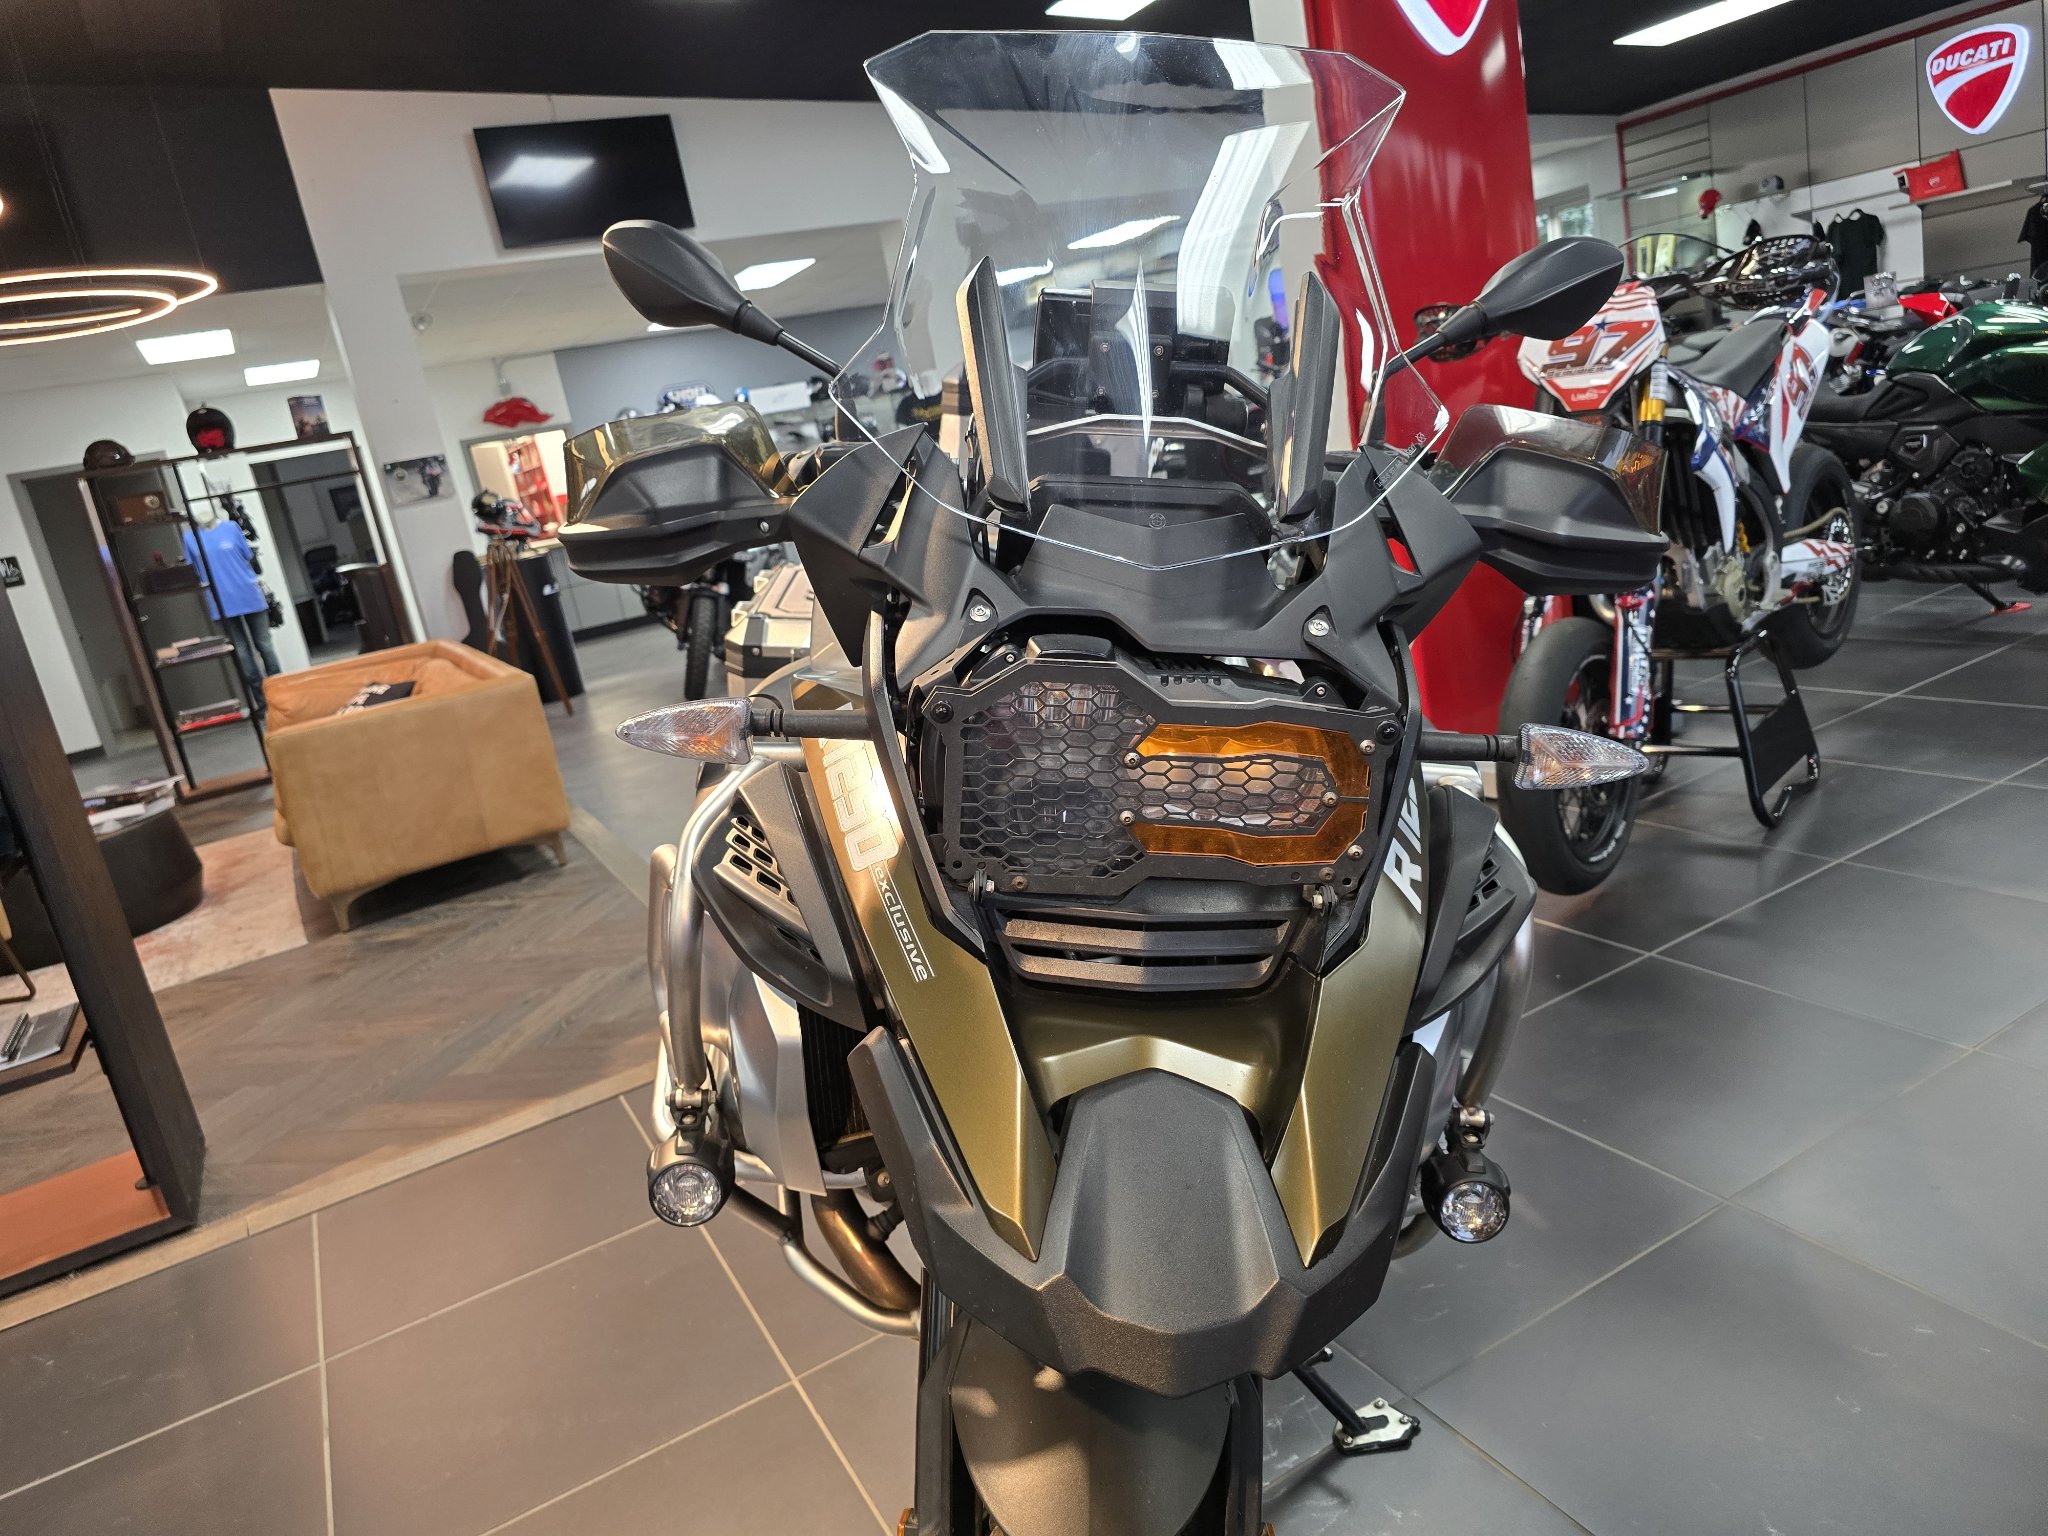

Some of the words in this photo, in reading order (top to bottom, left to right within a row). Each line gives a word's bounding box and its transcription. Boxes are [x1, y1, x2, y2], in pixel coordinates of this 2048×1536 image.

[1931, 37, 2011, 76] DUCATI
[1541, 320, 1657, 370] 97
[874, 866, 928, 982] exclusive
